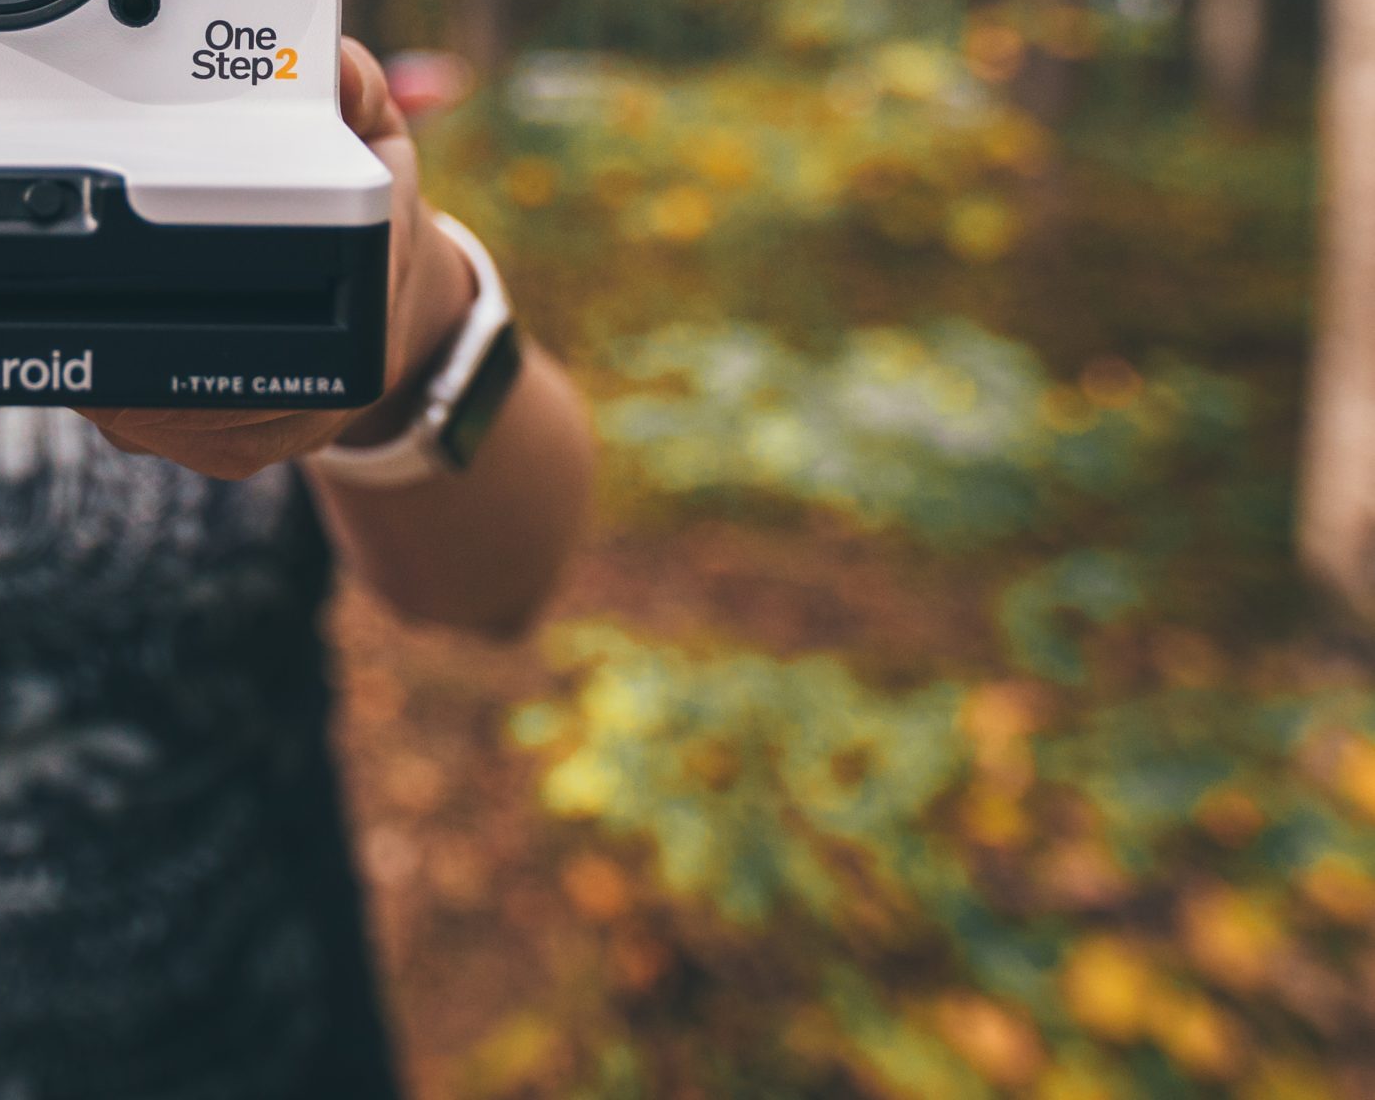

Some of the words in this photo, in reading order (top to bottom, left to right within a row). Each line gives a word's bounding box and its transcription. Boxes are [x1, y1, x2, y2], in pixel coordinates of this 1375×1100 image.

[204, 19, 277, 51] One
[191, 48, 299, 86] Step2
[171, 376, 243, 394] I-TYPE
[252, 376, 346, 394] CAMERA
